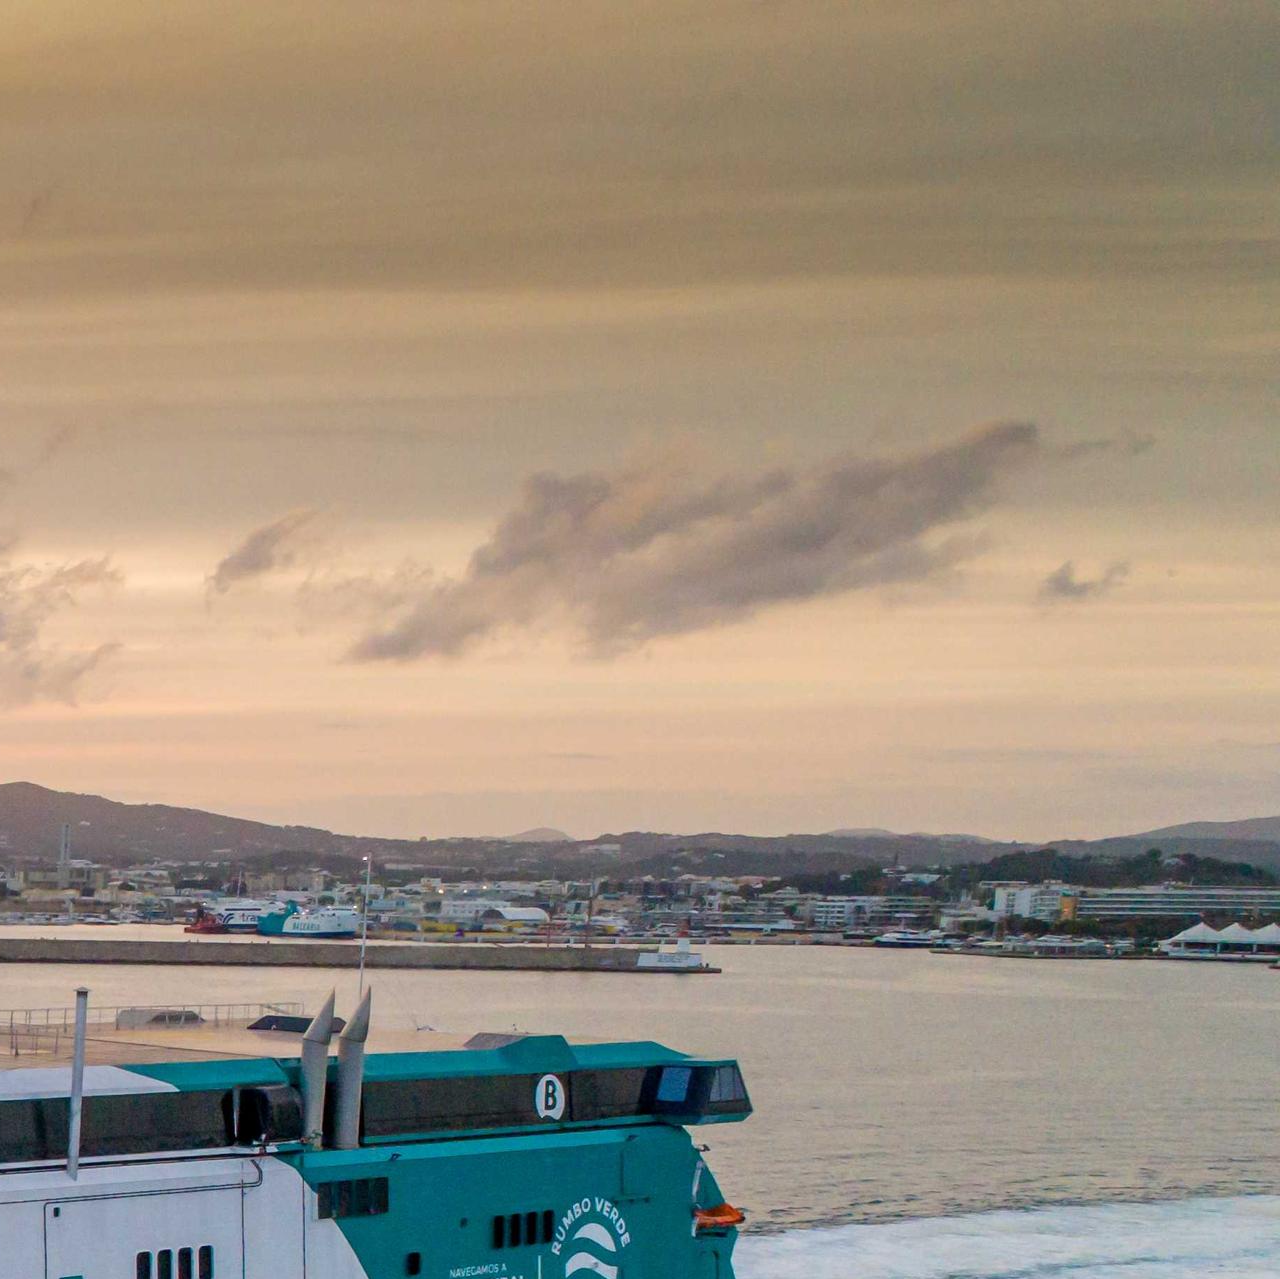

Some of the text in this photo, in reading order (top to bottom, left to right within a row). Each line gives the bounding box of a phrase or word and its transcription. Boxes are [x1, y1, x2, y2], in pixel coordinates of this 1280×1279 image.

[544, 1079, 557, 1111] B
[551, 1196, 631, 1256] RUMBO VERDE
[449, 1263, 499, 1278] NAVEGAMOS
